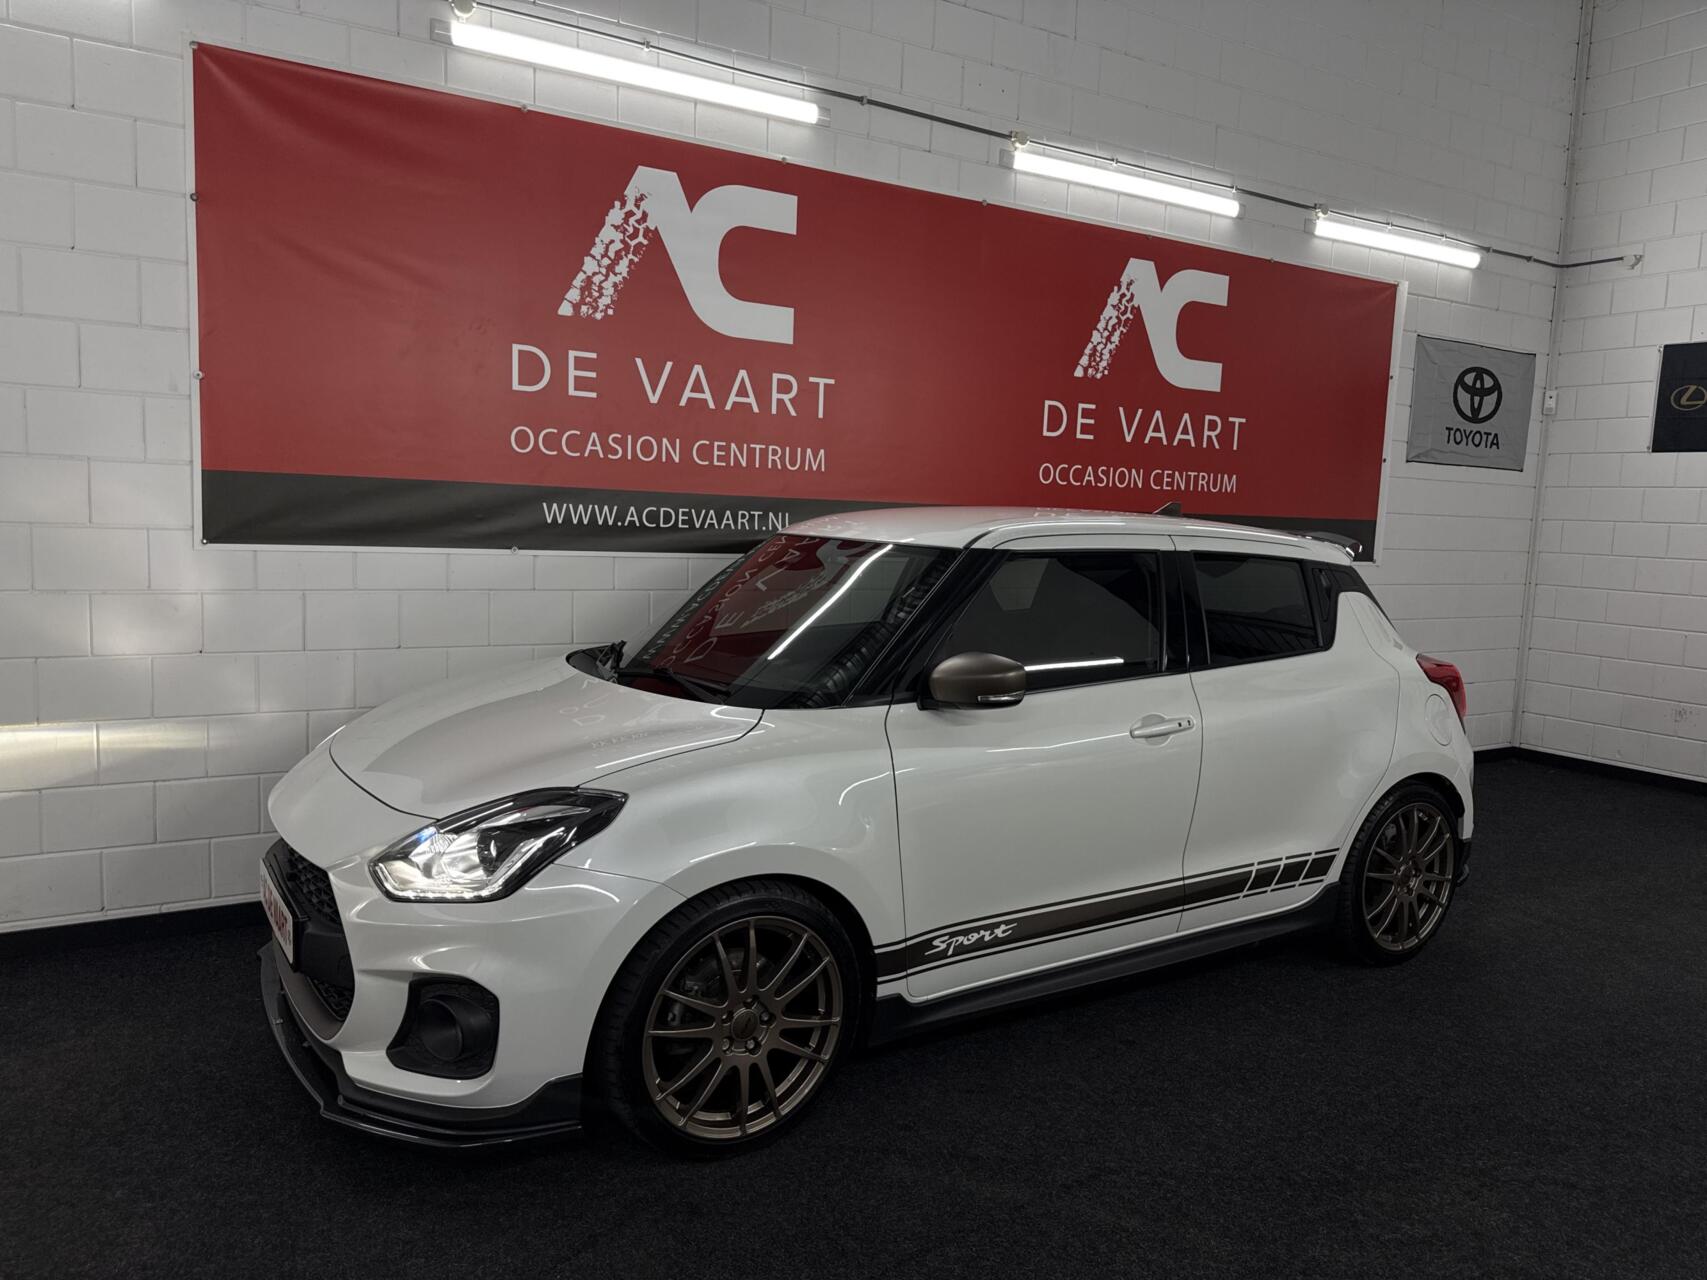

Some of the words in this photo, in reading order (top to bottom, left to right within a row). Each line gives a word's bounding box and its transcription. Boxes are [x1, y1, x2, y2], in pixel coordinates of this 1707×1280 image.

[557, 165, 798, 345] AC
[1073, 257, 1230, 393] AC
[511, 343, 598, 398] DE
[634, 357, 836, 420] VAART
[510, 426, 680, 464] OCCASION
[692, 439, 826, 472] CENTRUM
[1042, 400, 1097, 440] DE
[1118, 406, 1247, 451] VAART
[1445, 426, 1500, 450] TOYOTA
[1038, 463, 1144, 489] OCCASION
[1150, 469, 1237, 493] CENTRUM
[924, 924, 1018, 956] Sport
